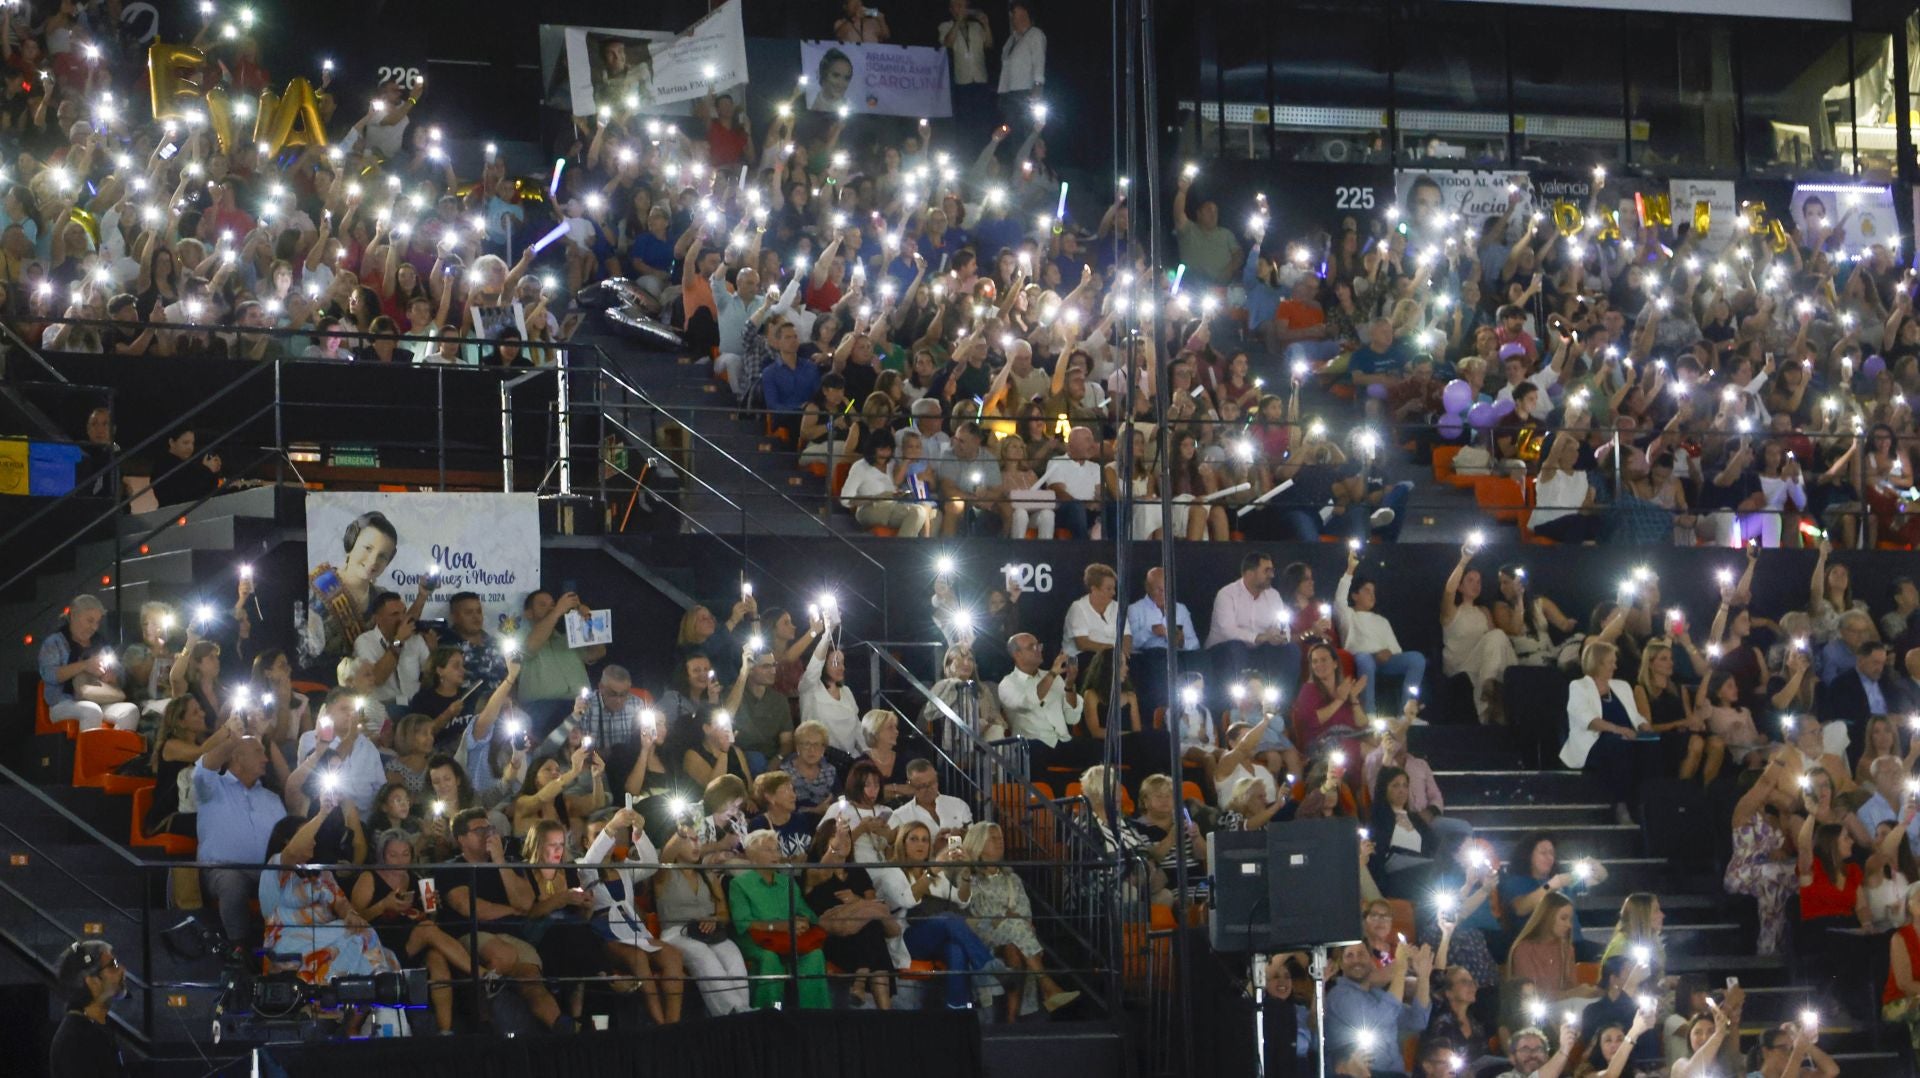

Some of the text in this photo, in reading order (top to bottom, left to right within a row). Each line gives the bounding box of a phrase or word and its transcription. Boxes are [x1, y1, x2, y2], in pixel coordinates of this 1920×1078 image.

[377, 66, 421, 90] 226
[657, 82, 688, 96] Marina
[1440, 177, 1470, 187] TODO
[1474, 178, 1488, 187] AL
[1539, 179, 1589, 195] valencia
[1336, 187, 1375, 209] 225
[431, 543, 477, 571] Noa
[465, 570, 471, 584] i
[1000, 563, 1053, 592] 126
[488, 592, 505, 603] 2024
